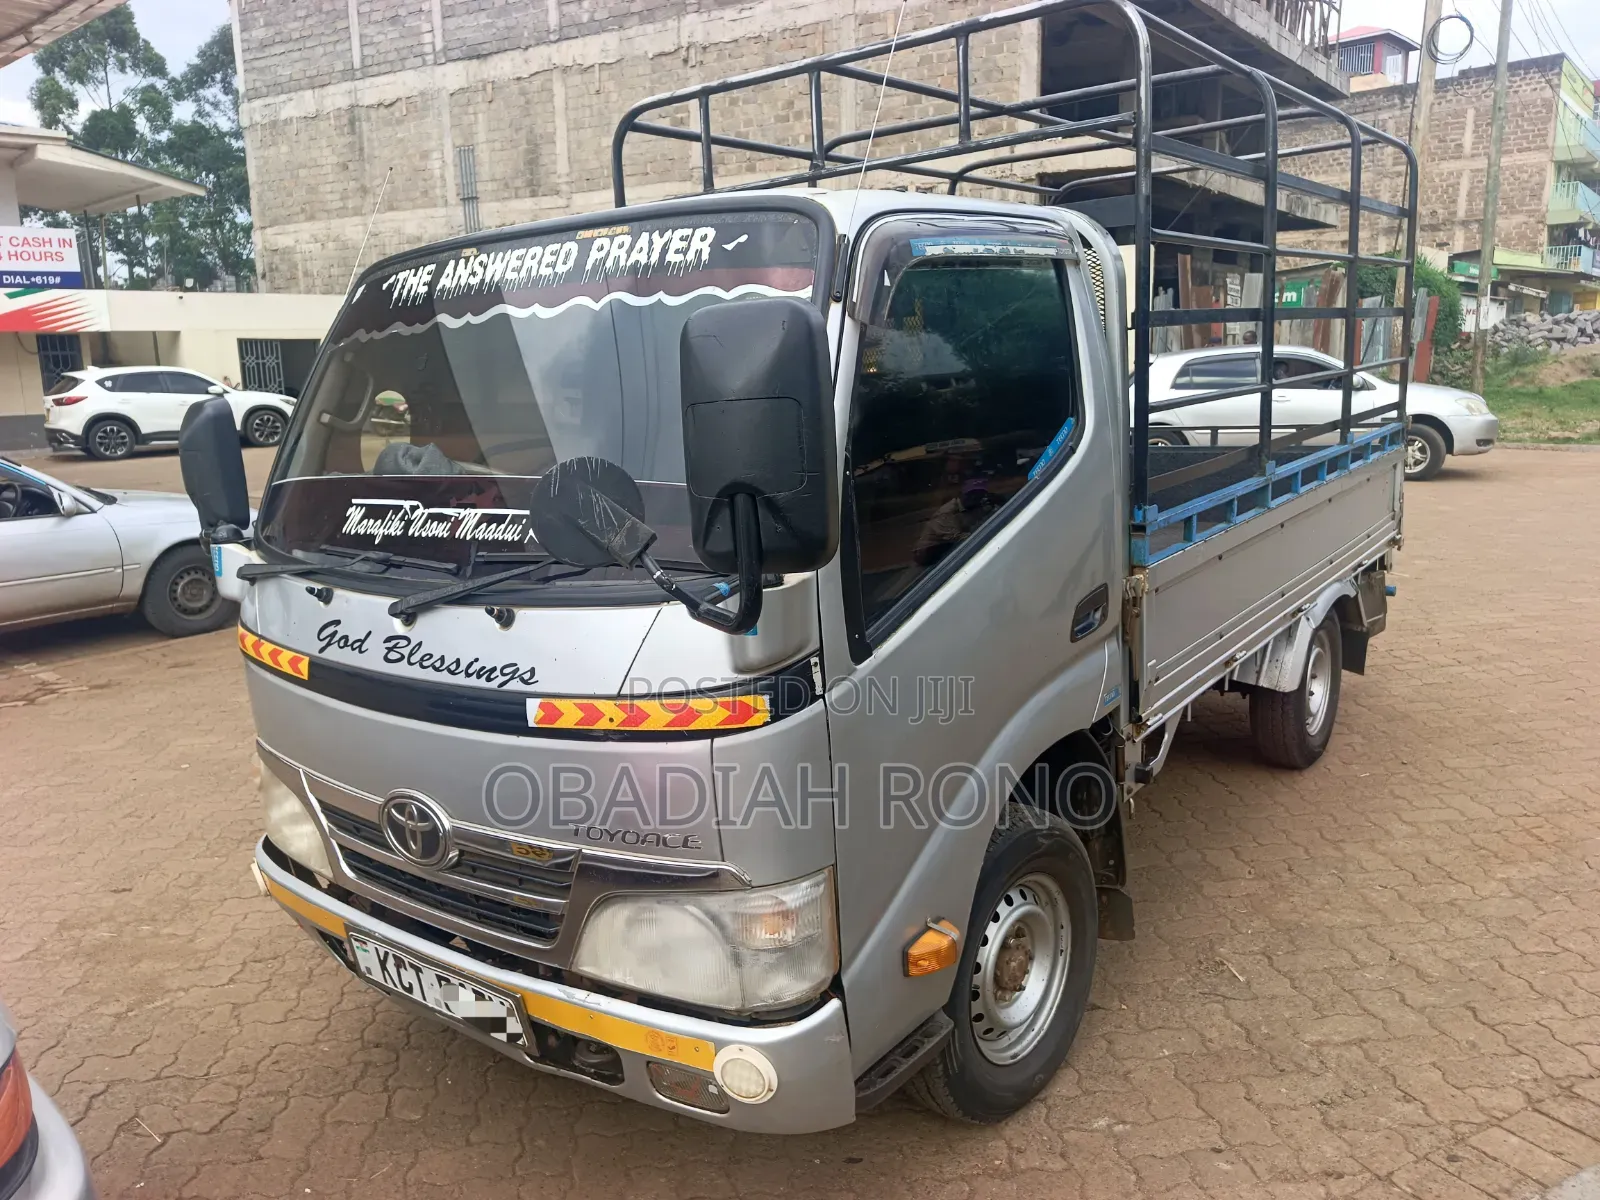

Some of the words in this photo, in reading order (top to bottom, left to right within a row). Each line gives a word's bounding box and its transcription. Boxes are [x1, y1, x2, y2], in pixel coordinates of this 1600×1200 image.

[7, 250, 65, 262] HOURS
[9, 236, 53, 248] CASH
[58, 238, 73, 249] IN
[389, 263, 436, 309] THE
[434, 241, 579, 300] ANSWERED
[581, 226, 717, 285] PRAYER
[342, 504, 407, 544] Marafiki
[407, 508, 456, 538] Usoni
[455, 507, 527, 541] Maadui
[316, 618, 373, 654] God
[382, 634, 539, 688] Blessings
[568, 822, 703, 850] TOYOACE
[374, 946, 427, 1002] KCT
